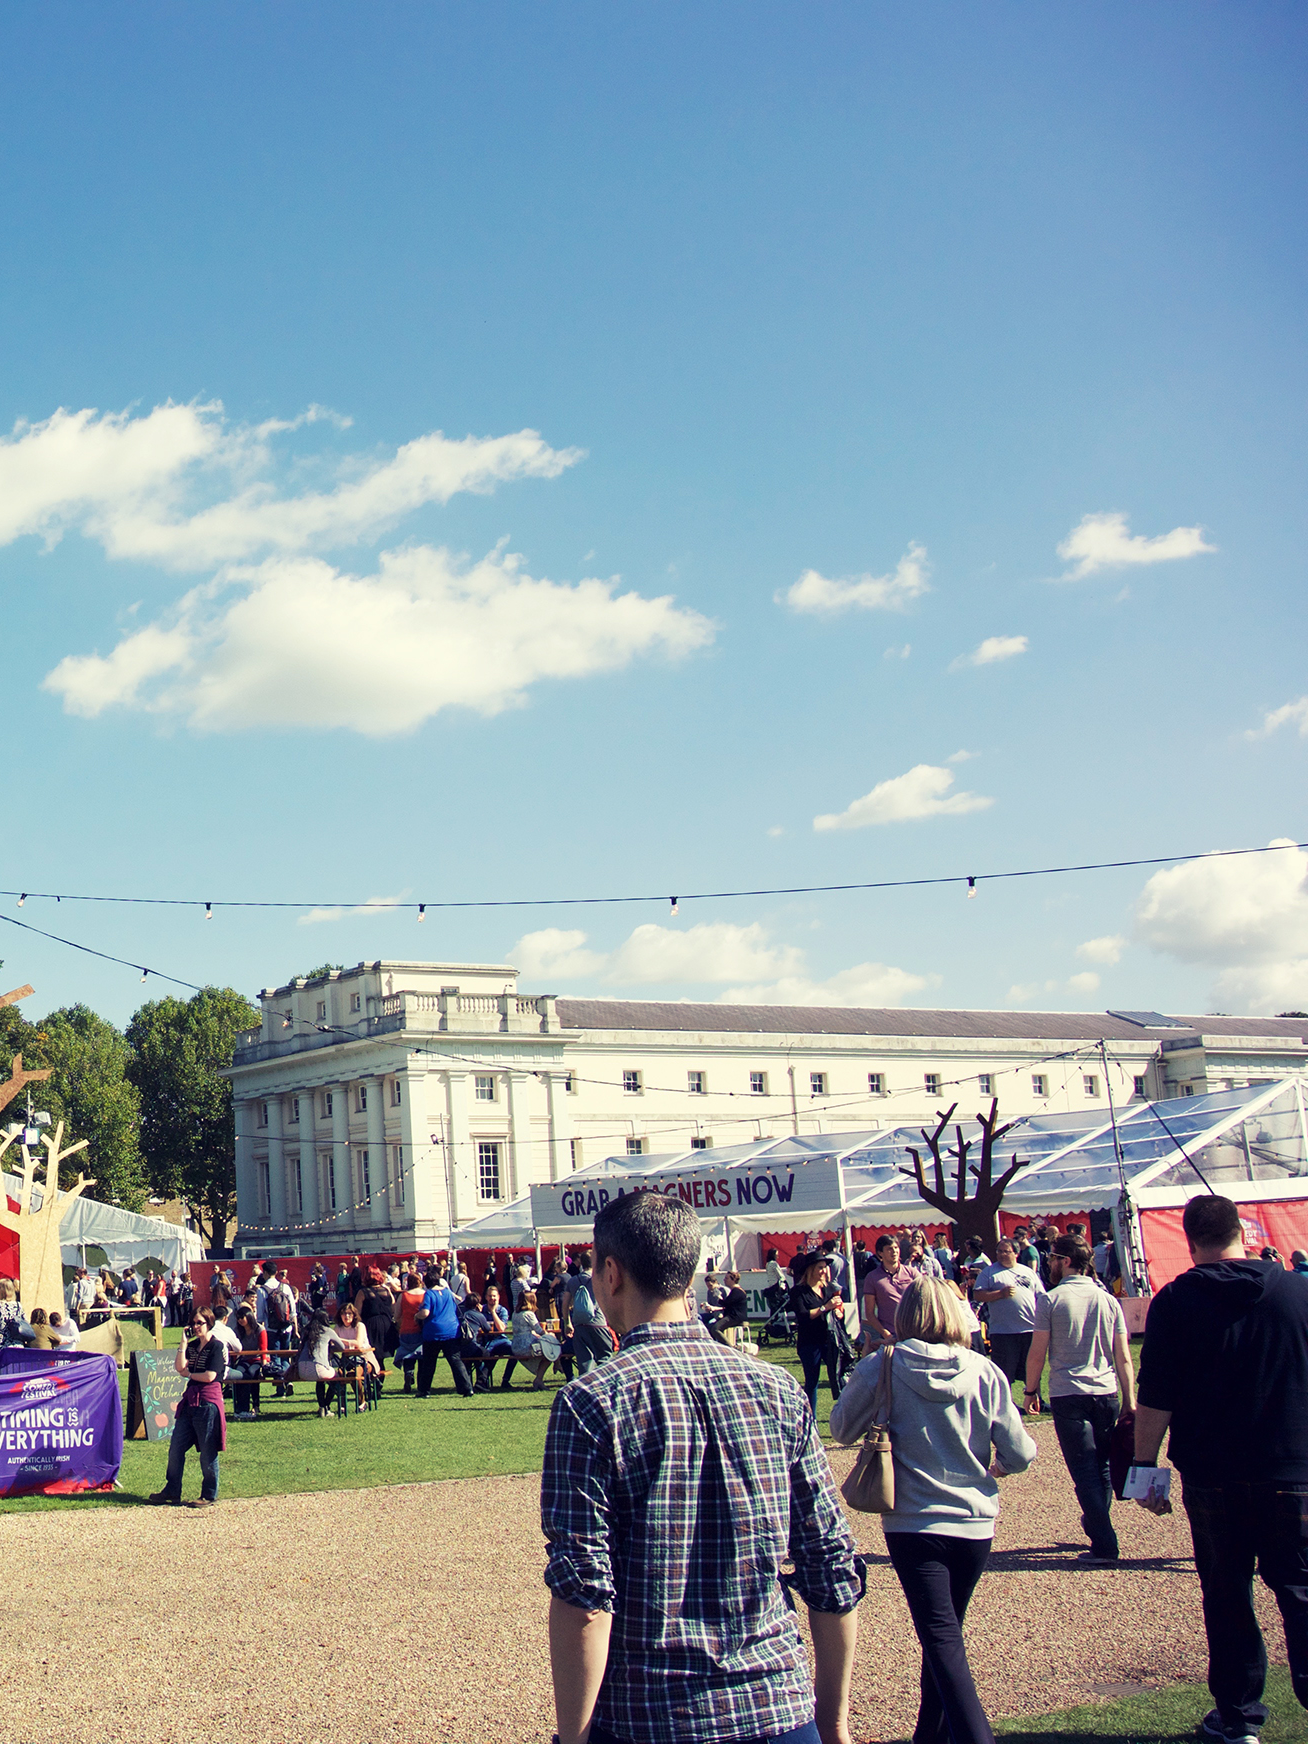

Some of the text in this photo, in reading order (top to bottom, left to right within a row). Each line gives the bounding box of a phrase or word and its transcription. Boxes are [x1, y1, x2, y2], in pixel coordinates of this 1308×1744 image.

[561, 1189, 610, 1216] GRAB
[633, 1179, 732, 1208] GNERS
[736, 1173, 795, 1205] NOW
[147, 1371, 182, 1390] Magners
[0, 1408, 79, 1428] TIMING IS
